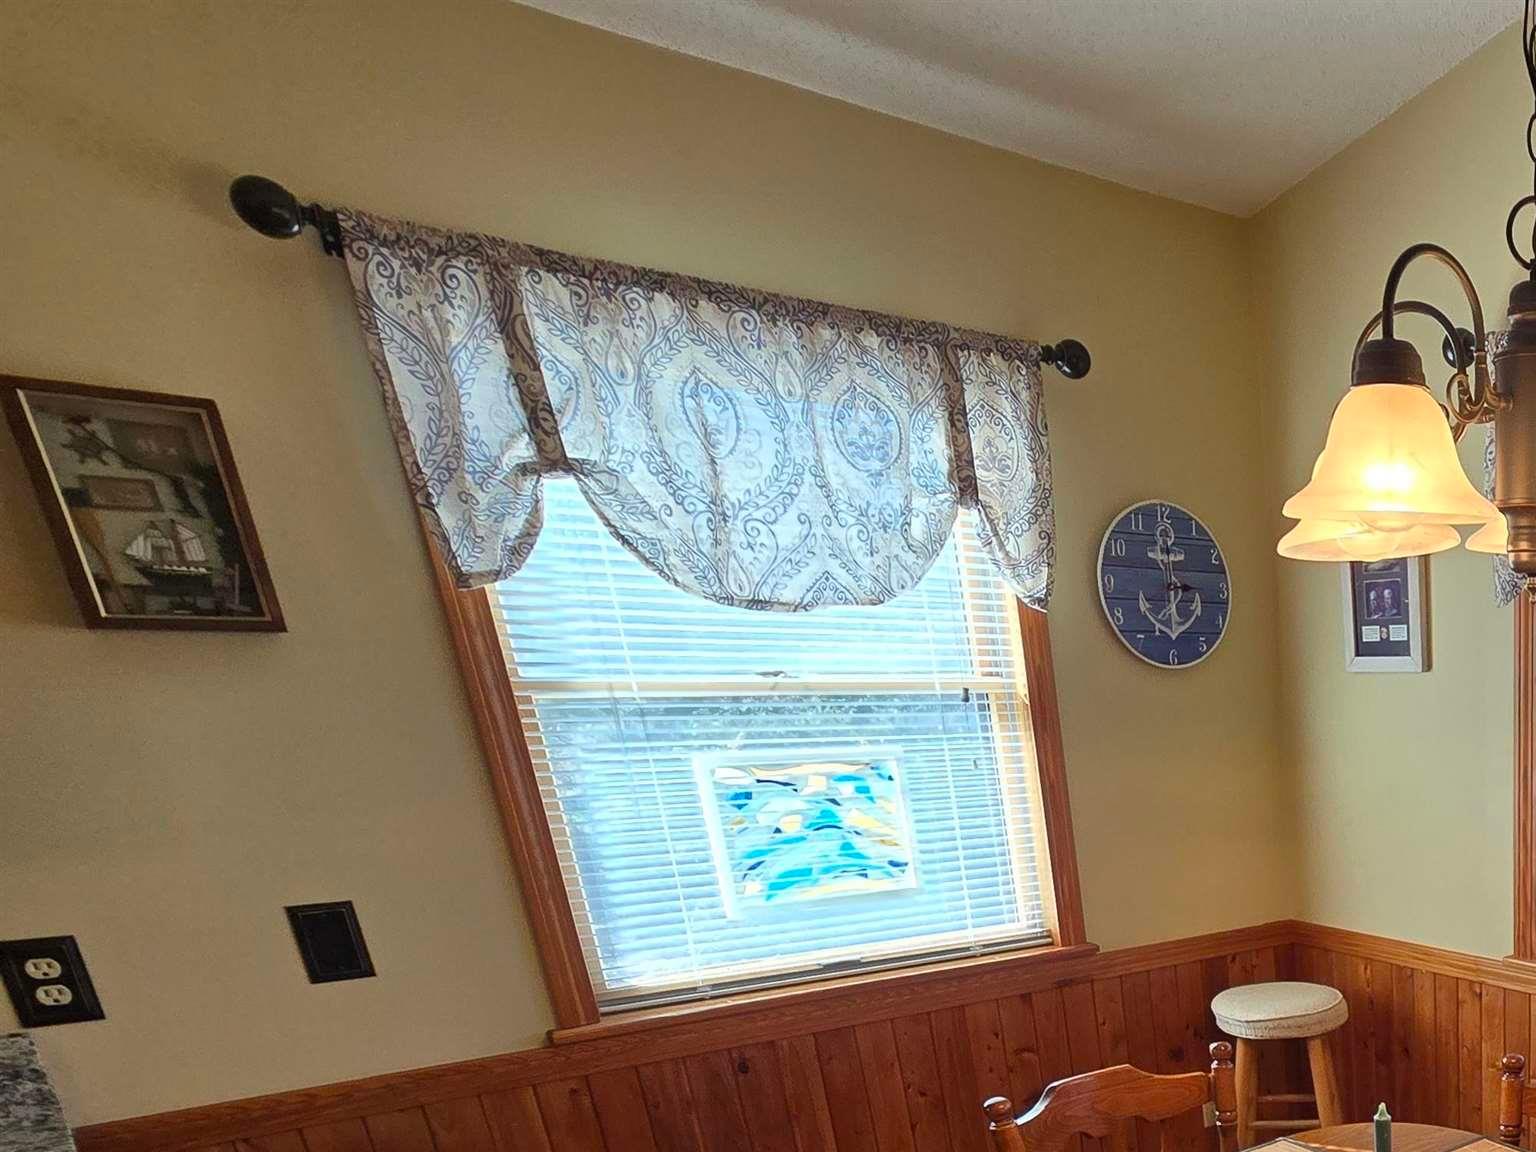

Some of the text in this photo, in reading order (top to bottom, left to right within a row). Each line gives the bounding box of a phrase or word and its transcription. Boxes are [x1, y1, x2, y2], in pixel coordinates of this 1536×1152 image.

[1130, 512, 1143, 531] 11
[1156, 505, 1172, 523] 12
[1190, 520, 1197, 536] 1
[1110, 538, 1126, 557] 10
[1210, 549, 1220, 565] 2
[1104, 575, 1114, 593] 9
[1219, 583, 1227, 599] 3
[1114, 607, 1124, 625] 8
[1199, 637, 1207, 651] 5
